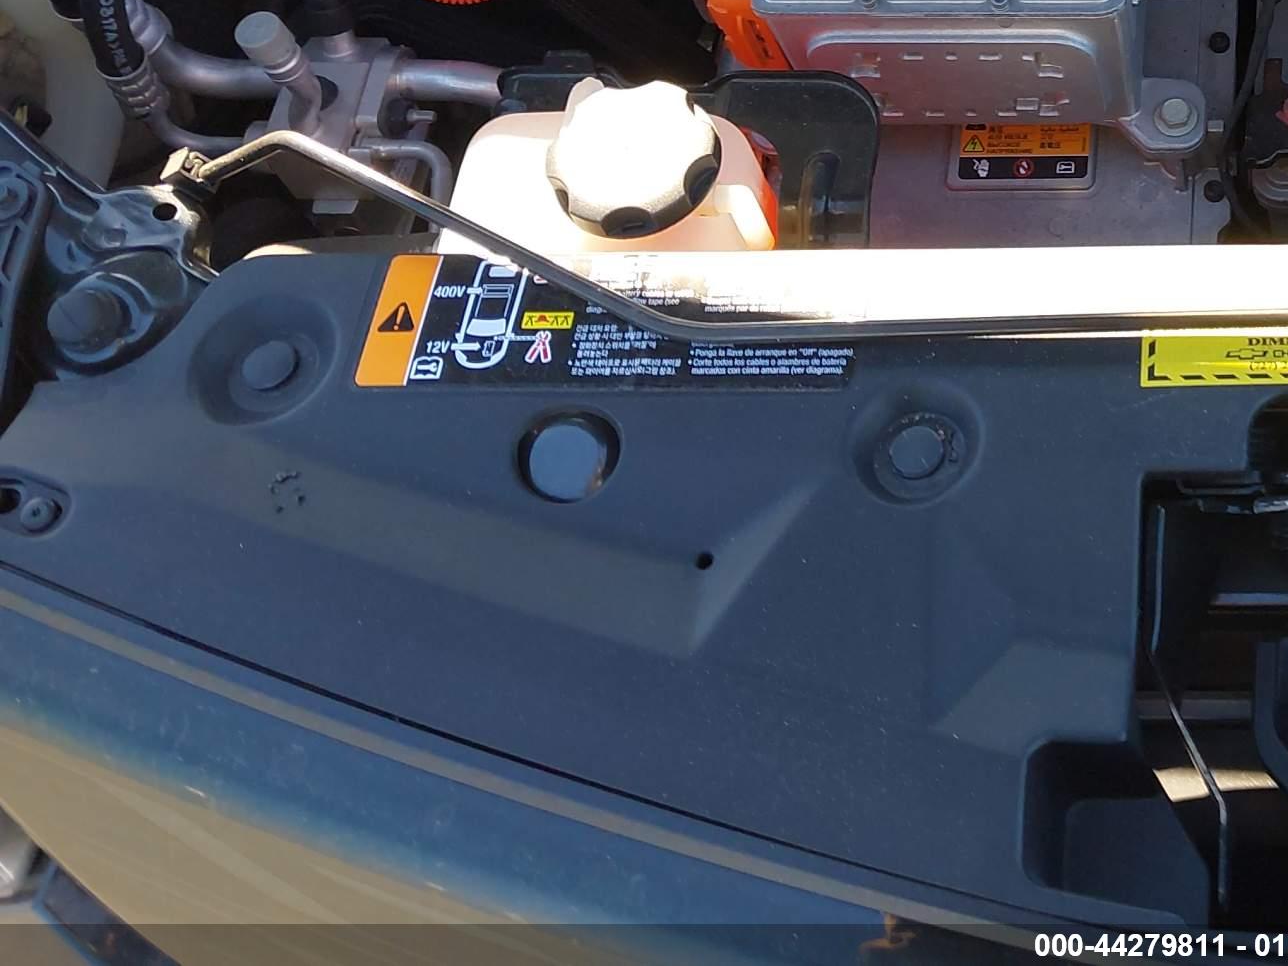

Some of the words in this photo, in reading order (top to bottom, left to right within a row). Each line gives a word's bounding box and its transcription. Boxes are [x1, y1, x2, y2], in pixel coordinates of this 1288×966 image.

[434, 286, 466, 297] 400V
[426, 340, 450, 354] 12V
[695, 348, 717, 358] Ponga
[718, 348, 725, 356] la
[727, 348, 743, 356] llave
[745, 348, 754, 356] de
[755, 349, 787, 358] arranque
[818, 348, 854, 357] (apagado)
[777, 358, 810, 366] alambres
[811, 358, 820, 366] de
[822, 358, 847, 366] batería
[790, 366, 805, 375] (ver
[806, 366, 844, 375] diagrama).
